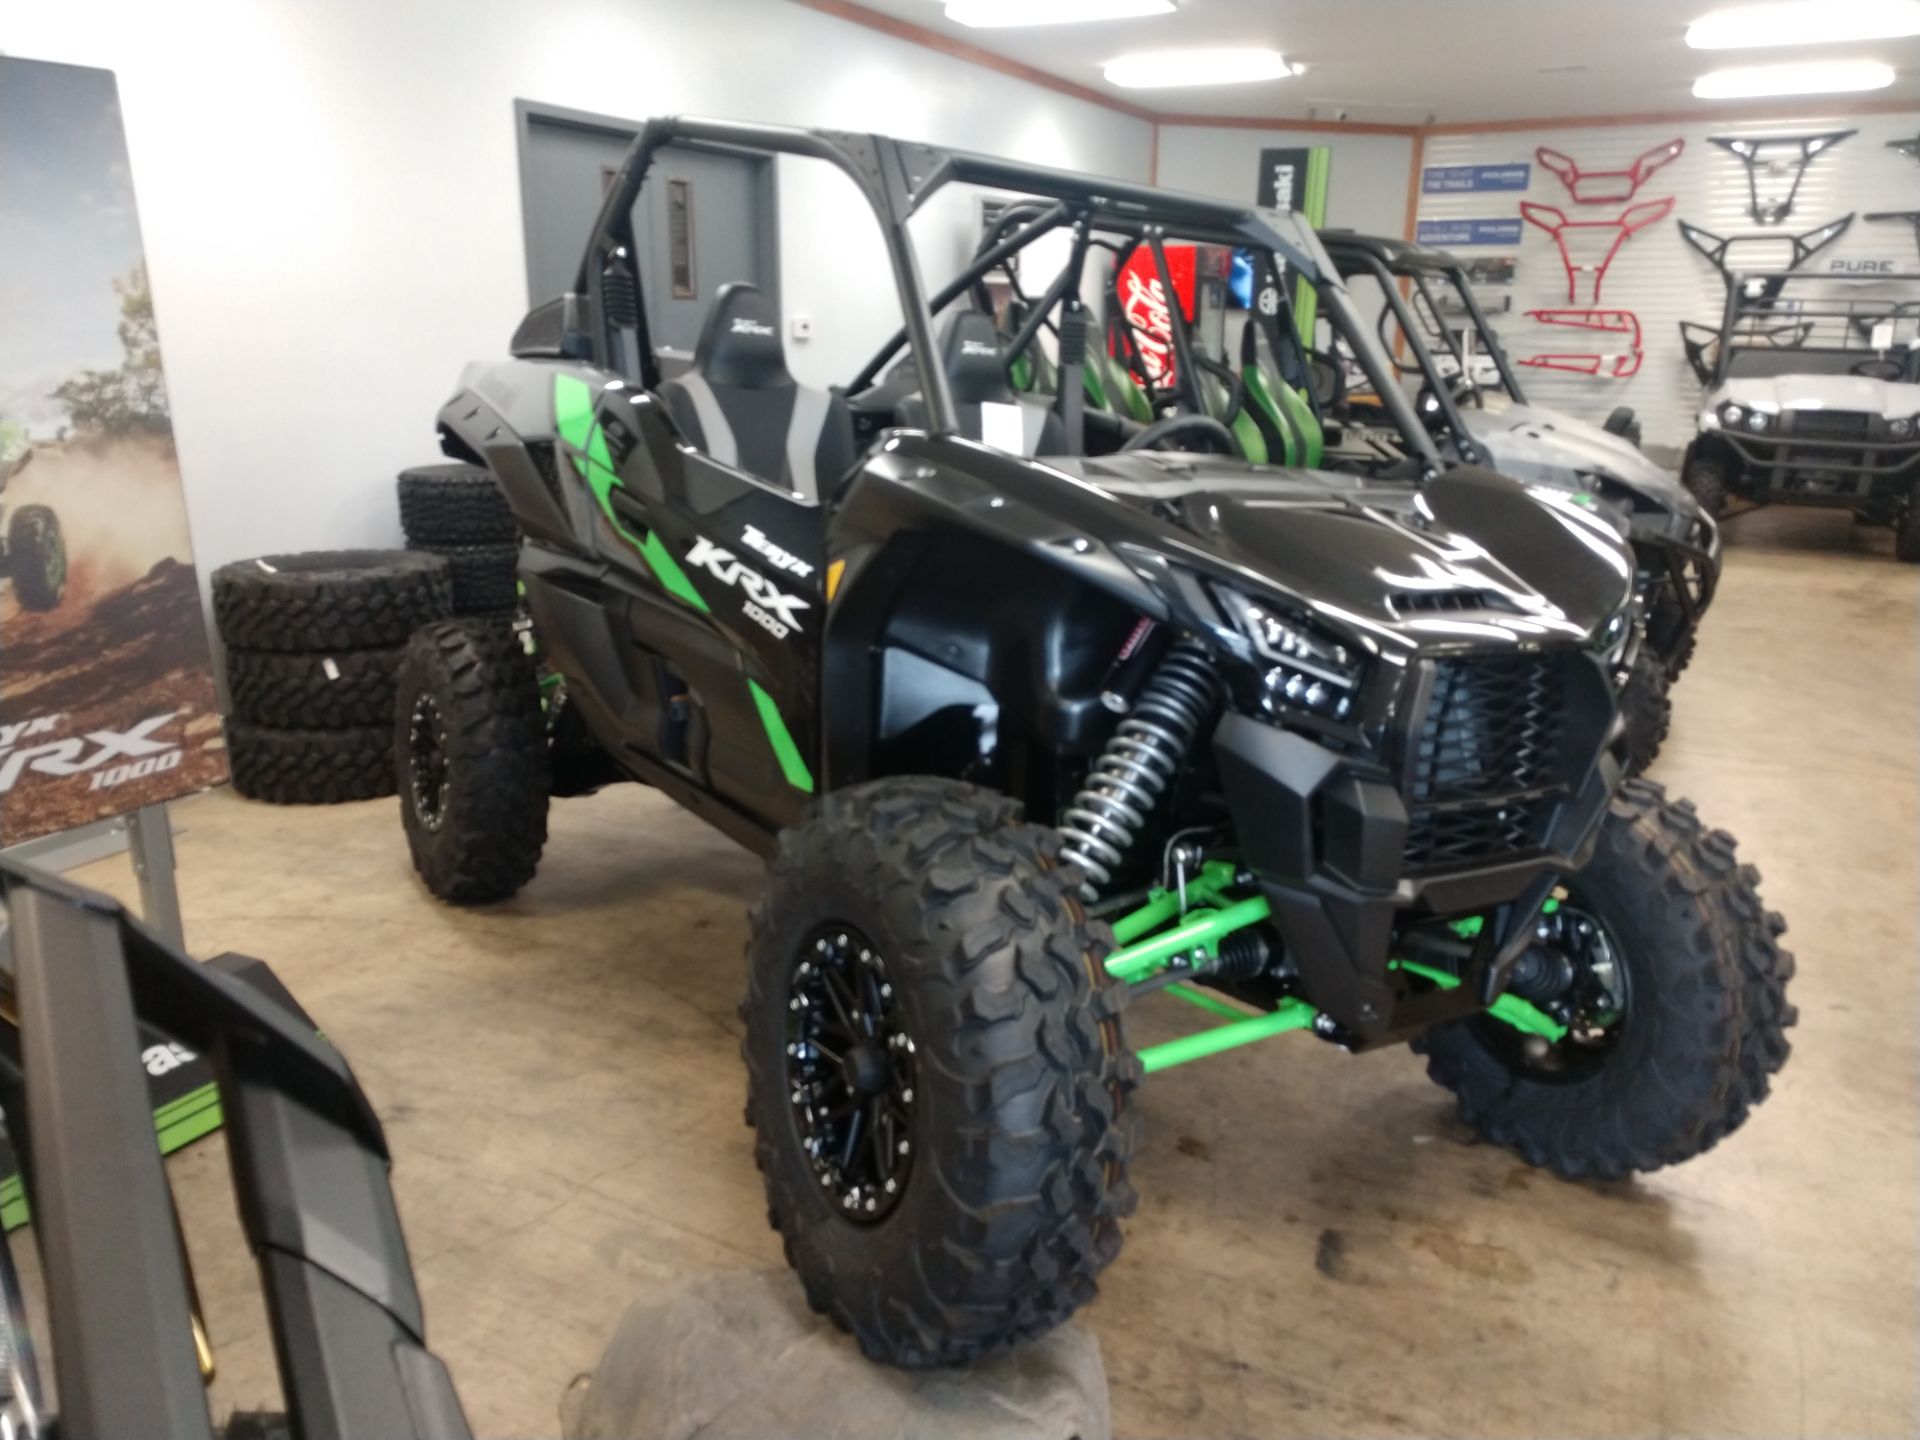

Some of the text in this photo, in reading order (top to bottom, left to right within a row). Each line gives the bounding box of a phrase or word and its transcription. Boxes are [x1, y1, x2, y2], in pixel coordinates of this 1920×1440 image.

[1830, 260, 1895, 273] PURE
[685, 534, 811, 633] KRX
[742, 600, 790, 640] 1000
[88, 749, 183, 791] 1000
